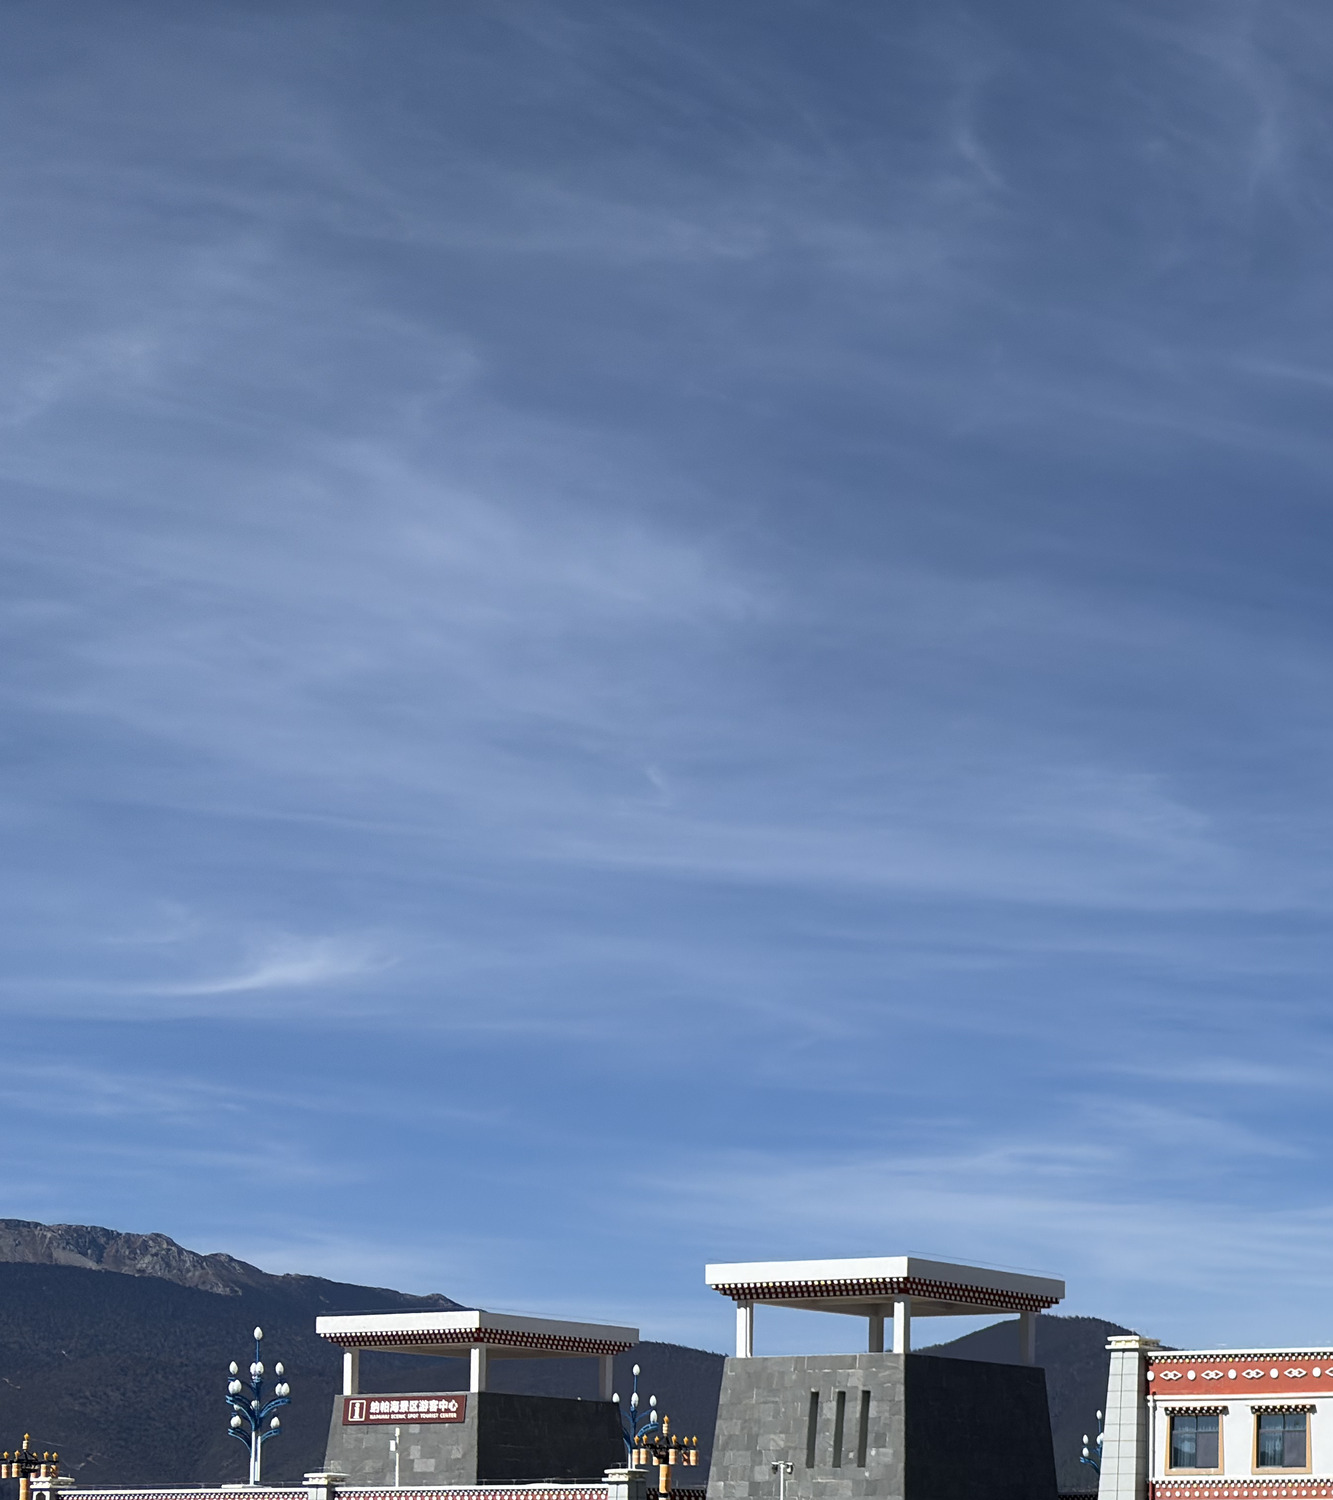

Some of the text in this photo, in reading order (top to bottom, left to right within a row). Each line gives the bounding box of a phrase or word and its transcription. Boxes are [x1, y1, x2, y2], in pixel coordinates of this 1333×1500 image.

[369, 1399, 459, 1413] 纳帕海景区游客中心
